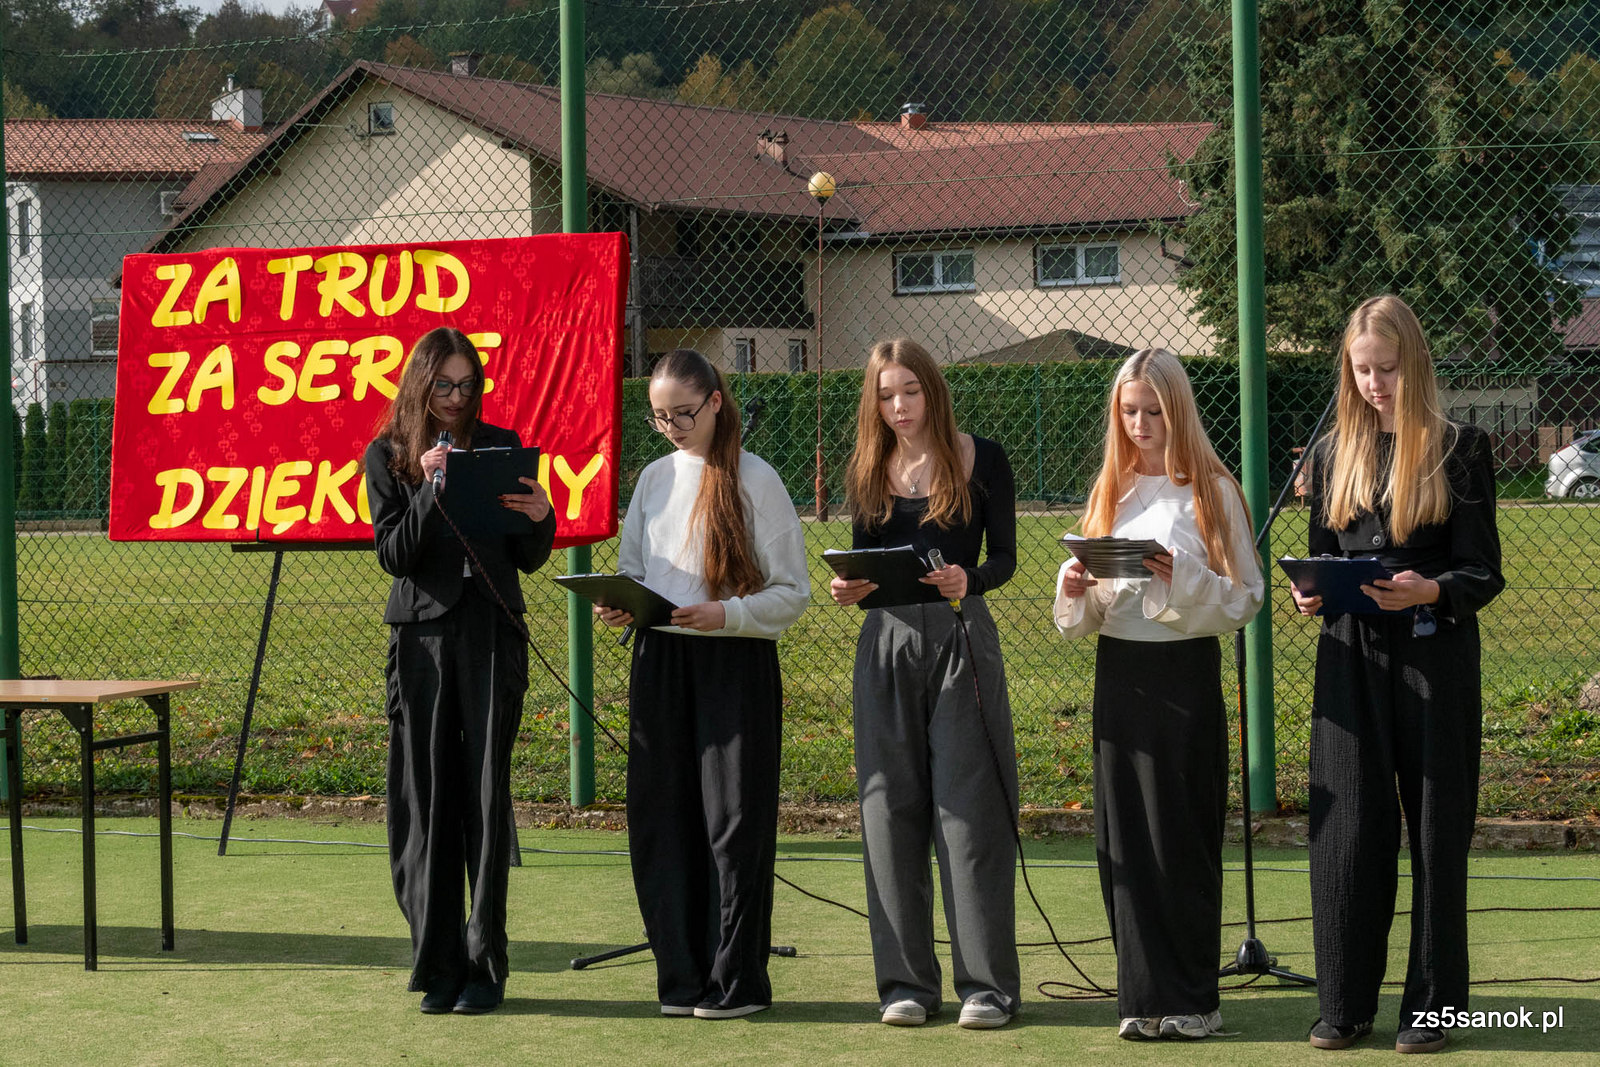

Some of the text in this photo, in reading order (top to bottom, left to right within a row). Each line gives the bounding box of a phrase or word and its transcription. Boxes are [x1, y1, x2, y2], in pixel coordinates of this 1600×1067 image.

[151, 249, 471, 328] ZA TRUD
[147, 332, 502, 415] ZA SERE
